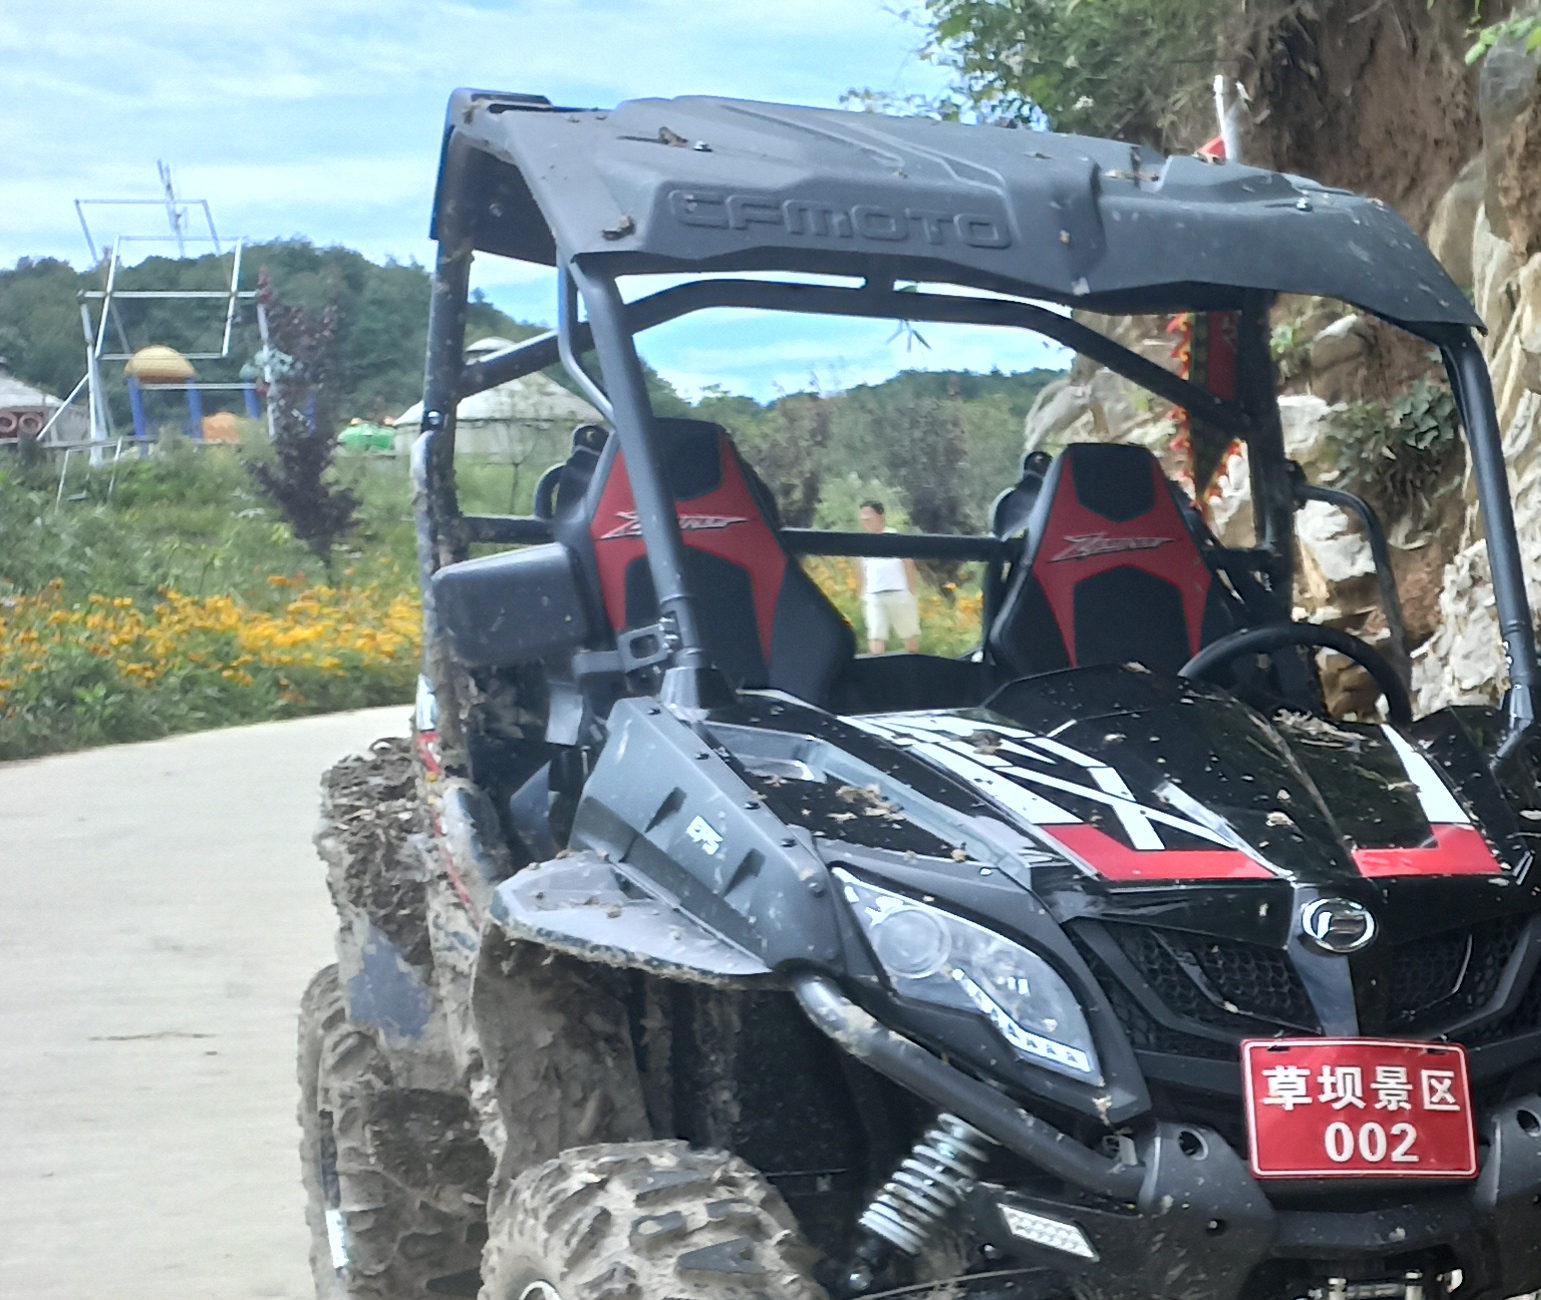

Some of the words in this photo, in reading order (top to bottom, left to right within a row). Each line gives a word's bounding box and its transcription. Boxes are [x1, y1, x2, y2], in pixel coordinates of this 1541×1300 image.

[667, 188, 1013, 250] CFMOTO
[1261, 1065, 1461, 1111] 草坝景区
[1324, 1121, 1420, 1163] 002
